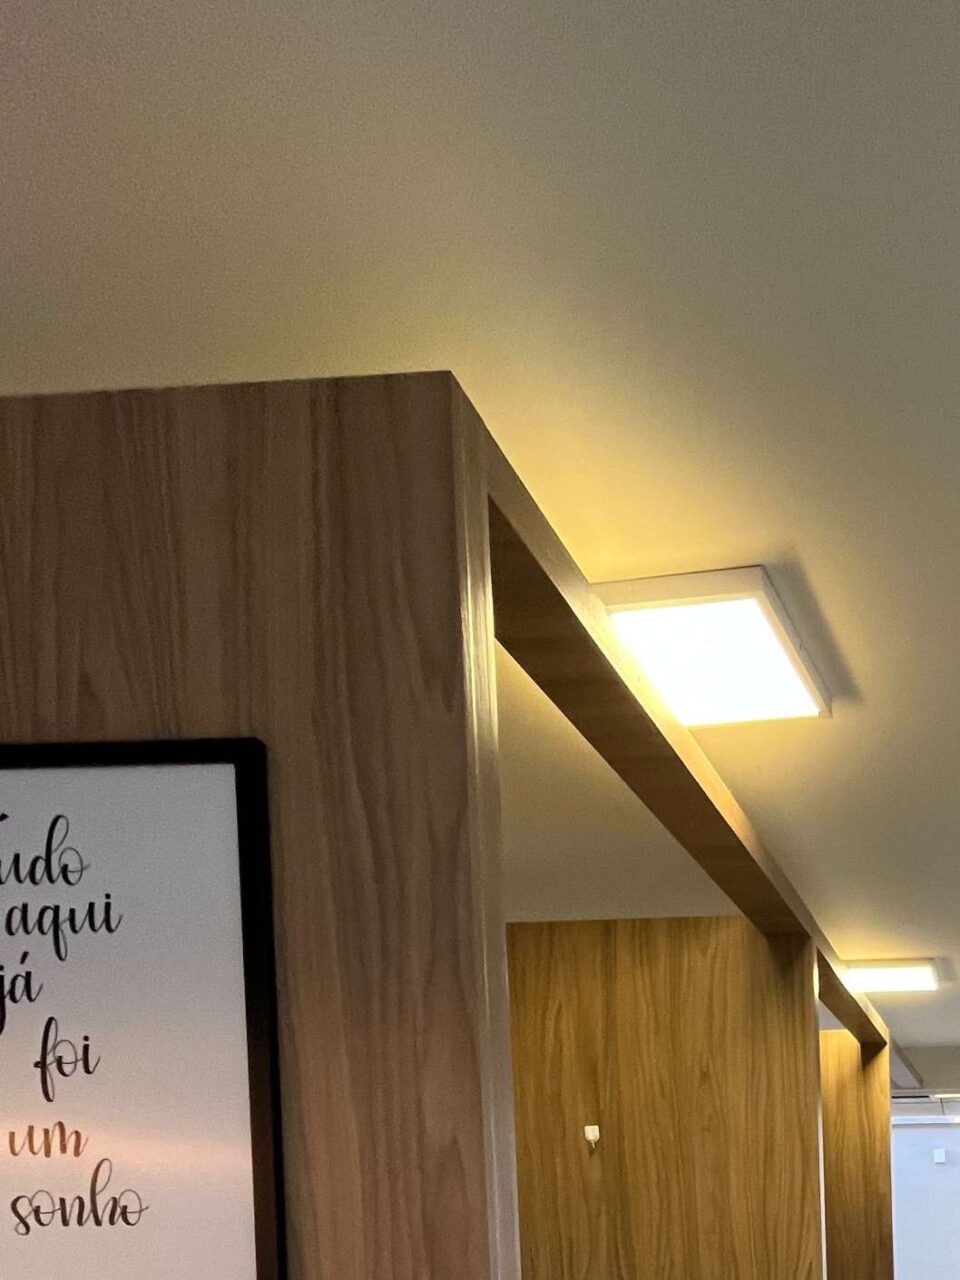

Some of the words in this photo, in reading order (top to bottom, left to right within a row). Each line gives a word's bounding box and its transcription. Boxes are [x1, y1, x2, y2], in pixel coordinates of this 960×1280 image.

[0, 813, 91, 886] udo
[5, 893, 123, 961] aqui
[33, 1016, 101, 1103] foi
[8, 1121, 89, 1158] um
[10, 1158, 149, 1236] sonho
